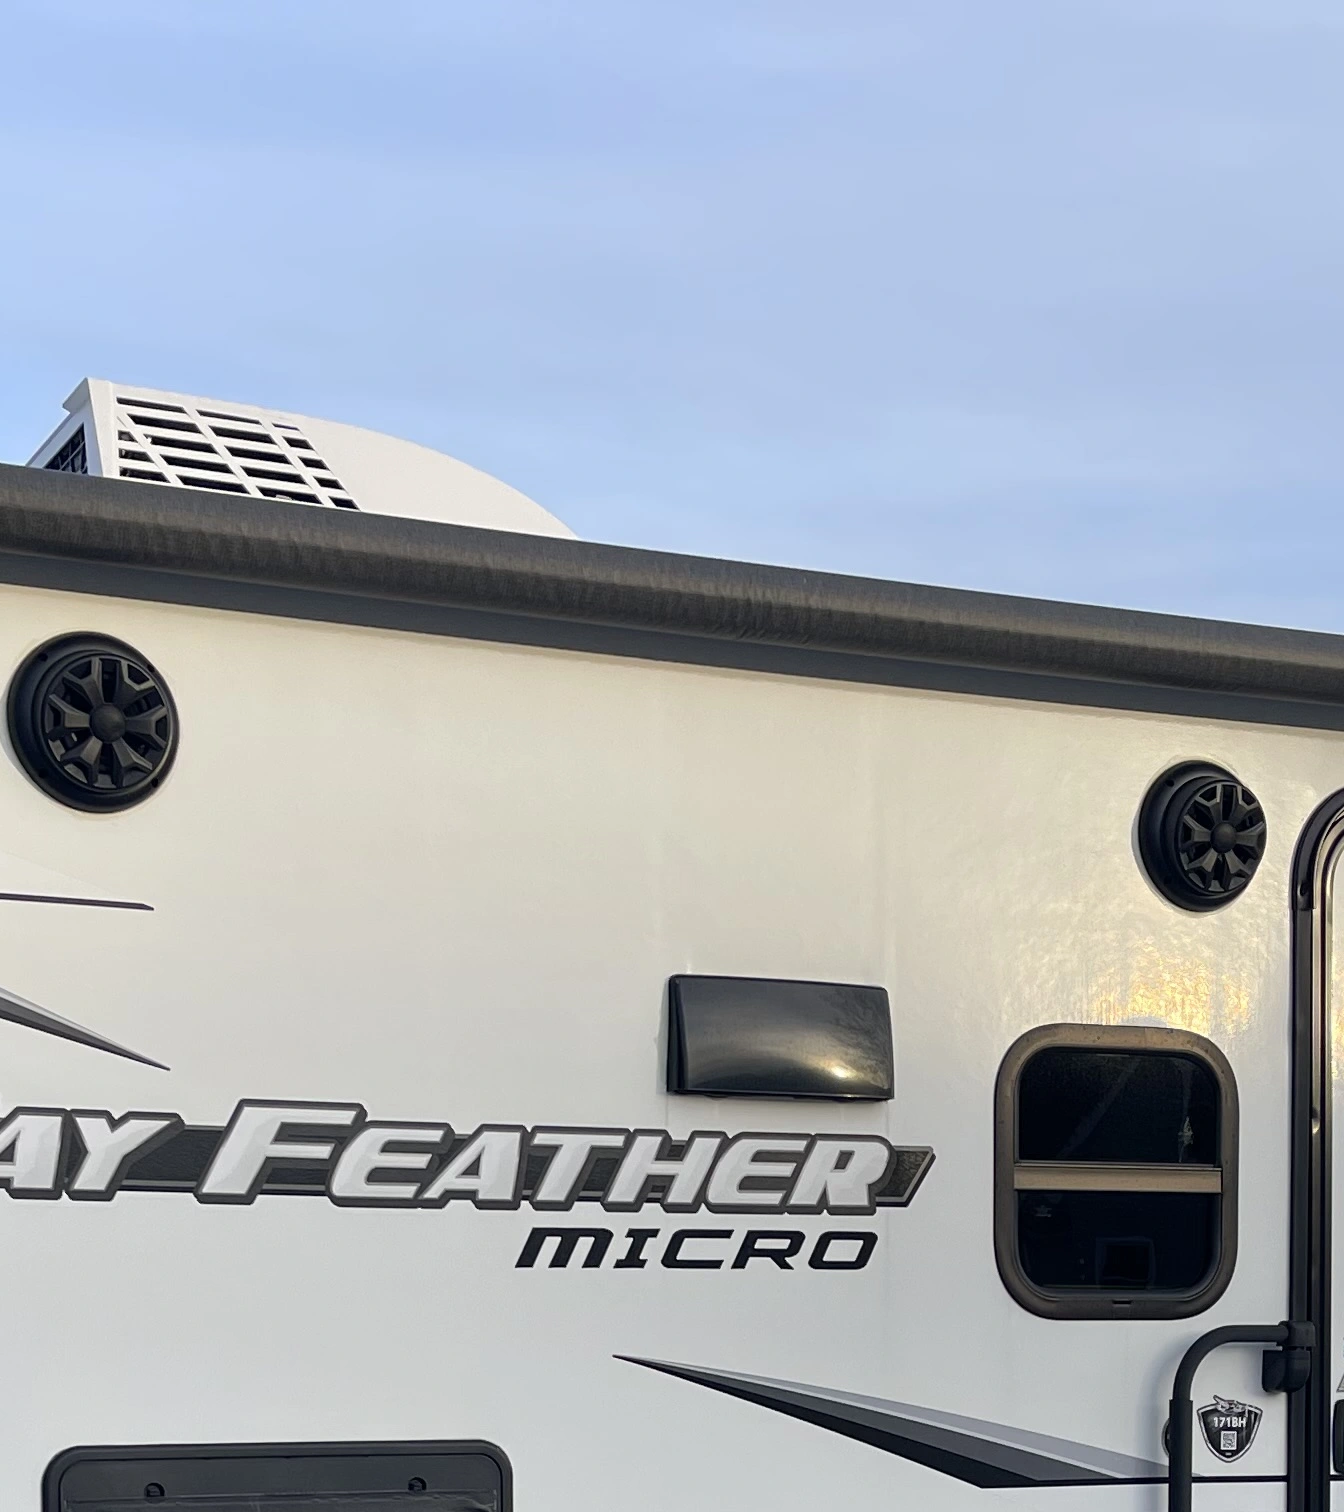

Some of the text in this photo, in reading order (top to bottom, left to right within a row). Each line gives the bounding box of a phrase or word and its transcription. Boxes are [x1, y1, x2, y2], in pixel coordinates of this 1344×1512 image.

[195, 1098, 895, 1214] FEATHER
[515, 1227, 878, 1270] MICRO
[1213, 1416, 1247, 1428] 171BH
